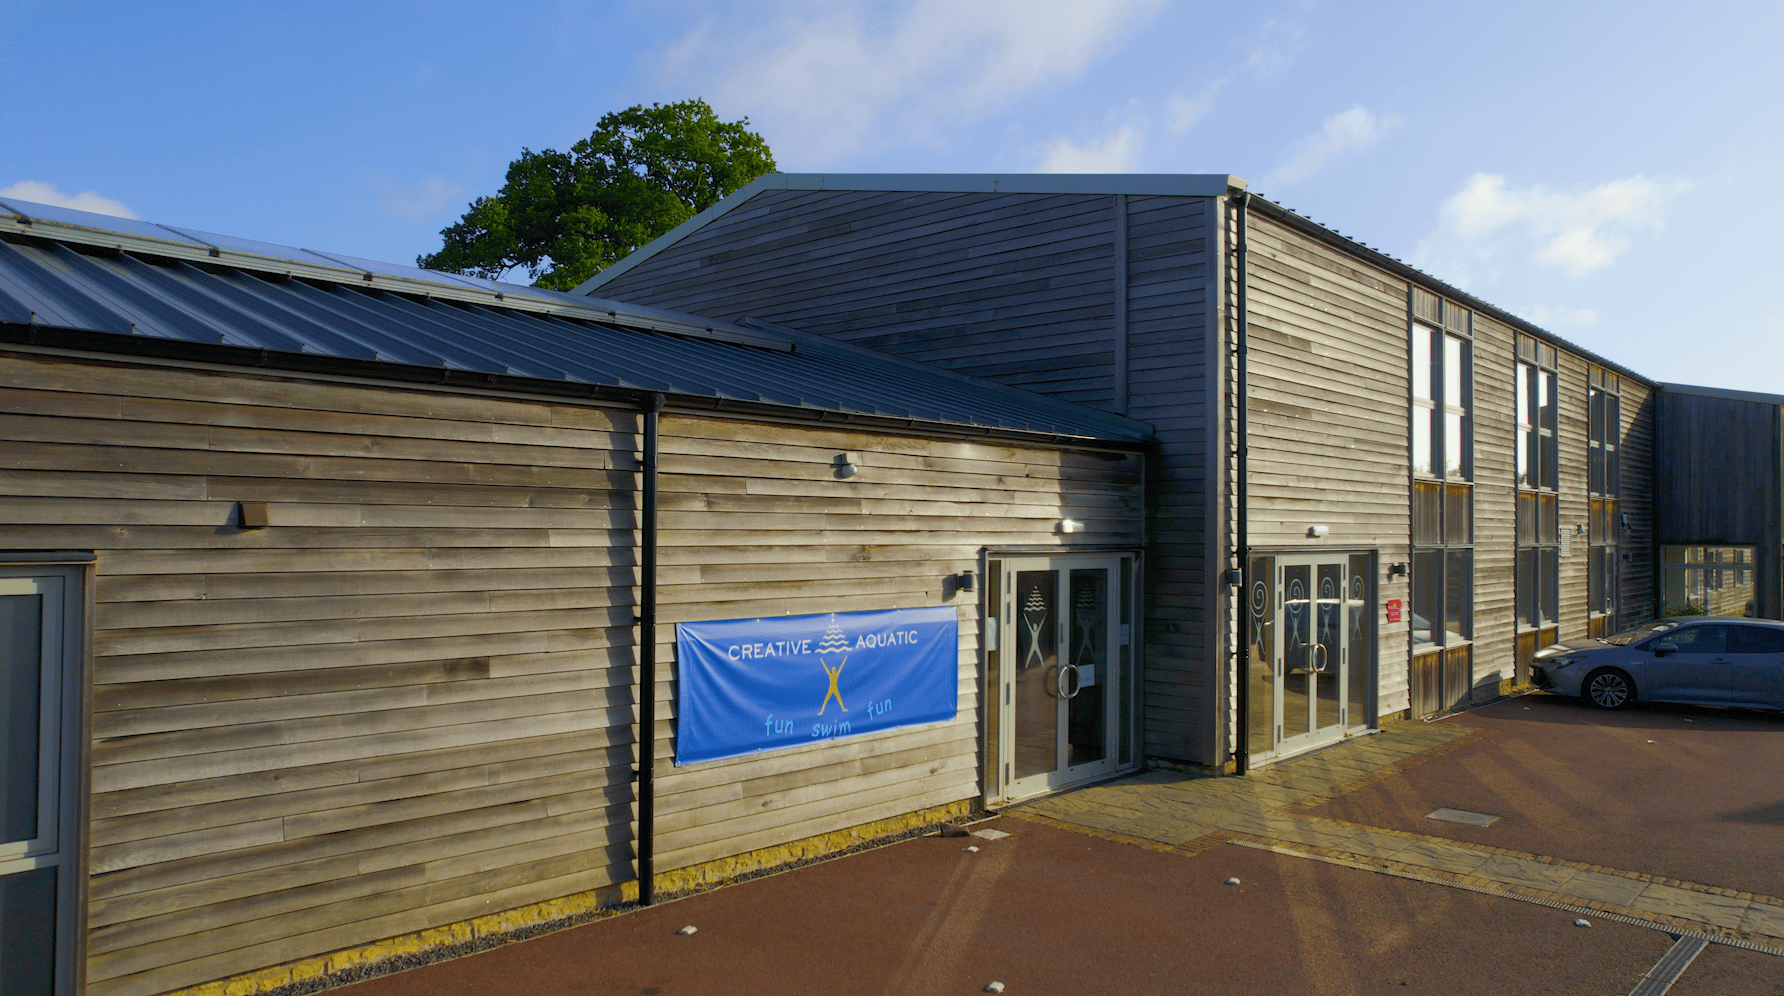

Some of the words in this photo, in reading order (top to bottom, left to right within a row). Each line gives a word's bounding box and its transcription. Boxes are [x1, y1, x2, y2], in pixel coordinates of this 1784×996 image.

[728, 639, 812, 661] CREATIVE
[855, 630, 918, 649] AQUATIC
[764, 714, 794, 736] fun
[811, 718, 851, 737] swim
[867, 698, 892, 720] fun
